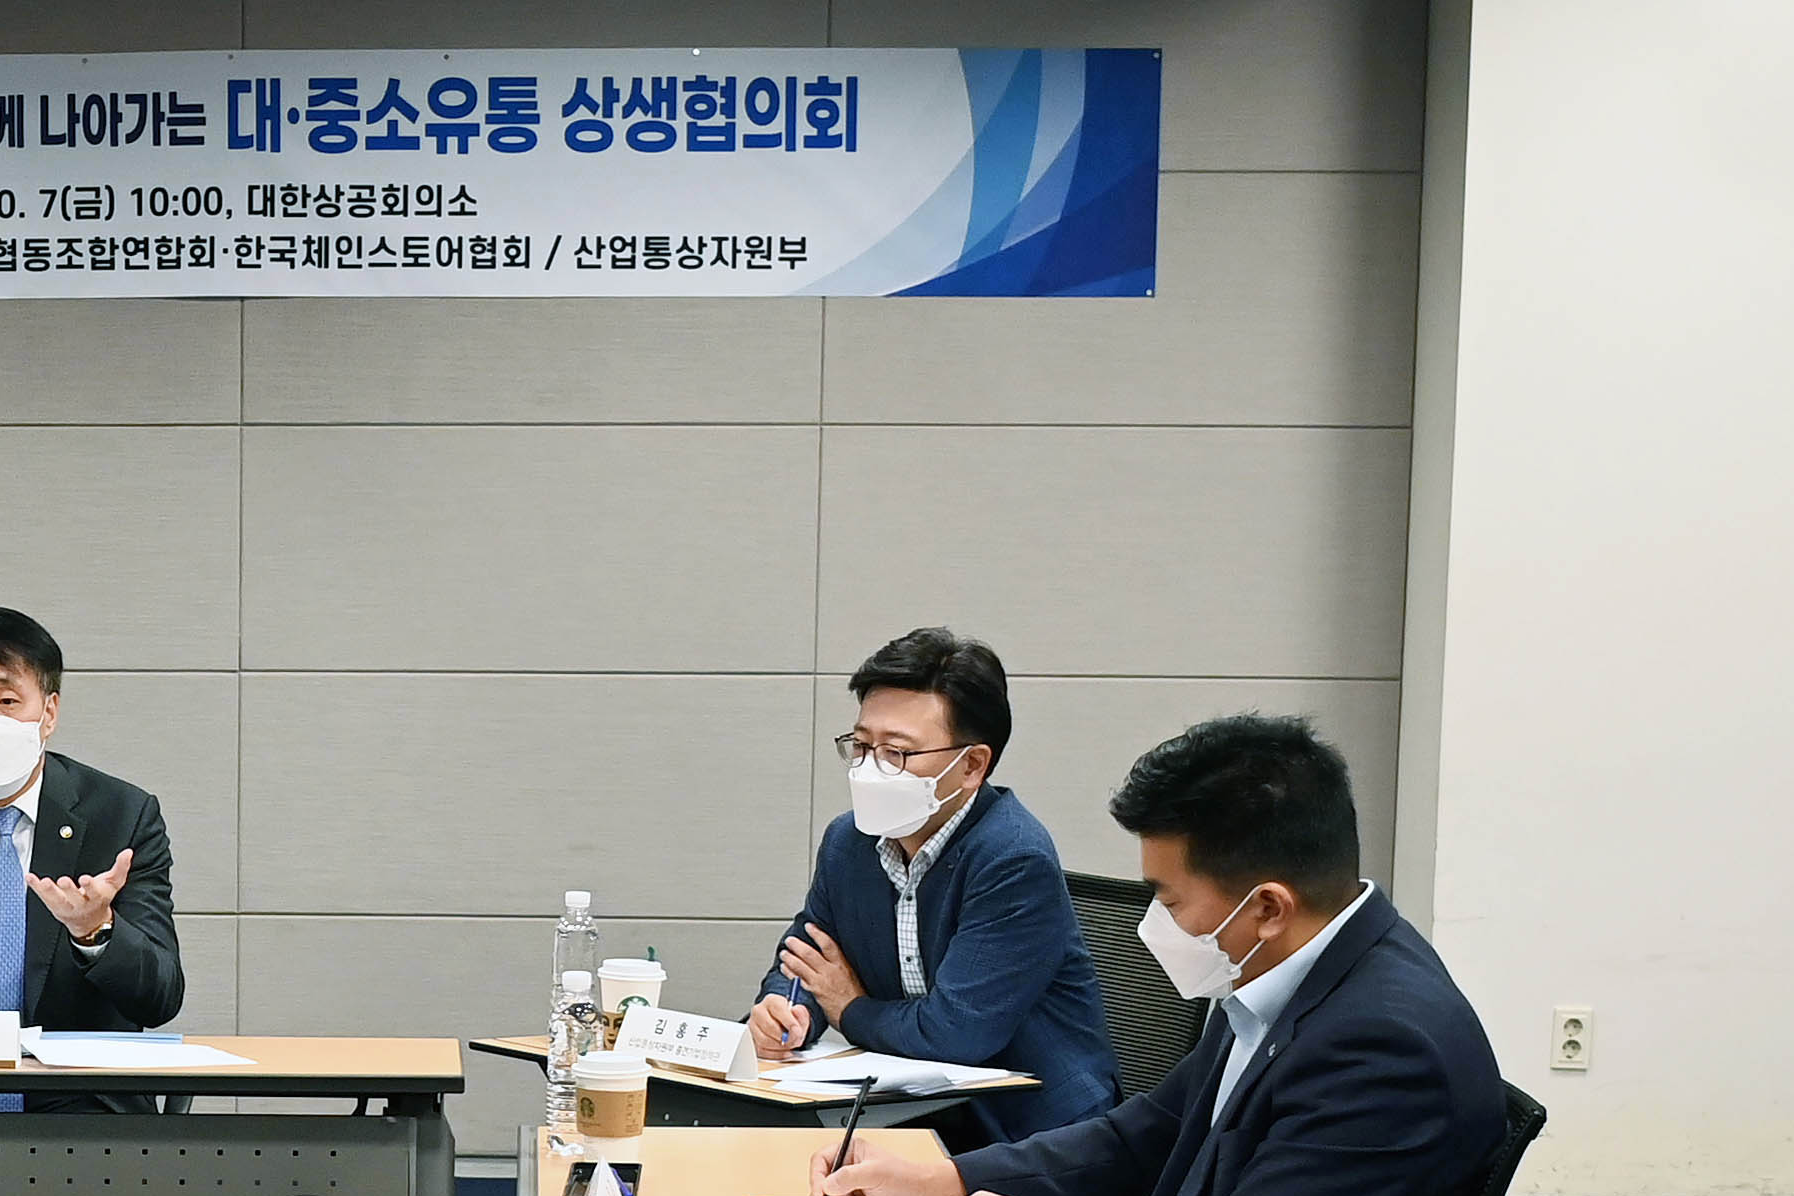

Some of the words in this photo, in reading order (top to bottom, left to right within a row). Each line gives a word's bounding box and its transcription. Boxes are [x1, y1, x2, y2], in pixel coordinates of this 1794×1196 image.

[39, 89, 207, 148] 나아가는
[226, 76, 541, 155] 대·중소유통
[561, 74, 859, 154] 상생협의회
[38, 184, 115, 222] 7(금)
[130, 186, 233, 222] 10:00,
[247, 182, 478, 219] 대한상공회의소
[573, 234, 808, 271] 산업통상자원부
